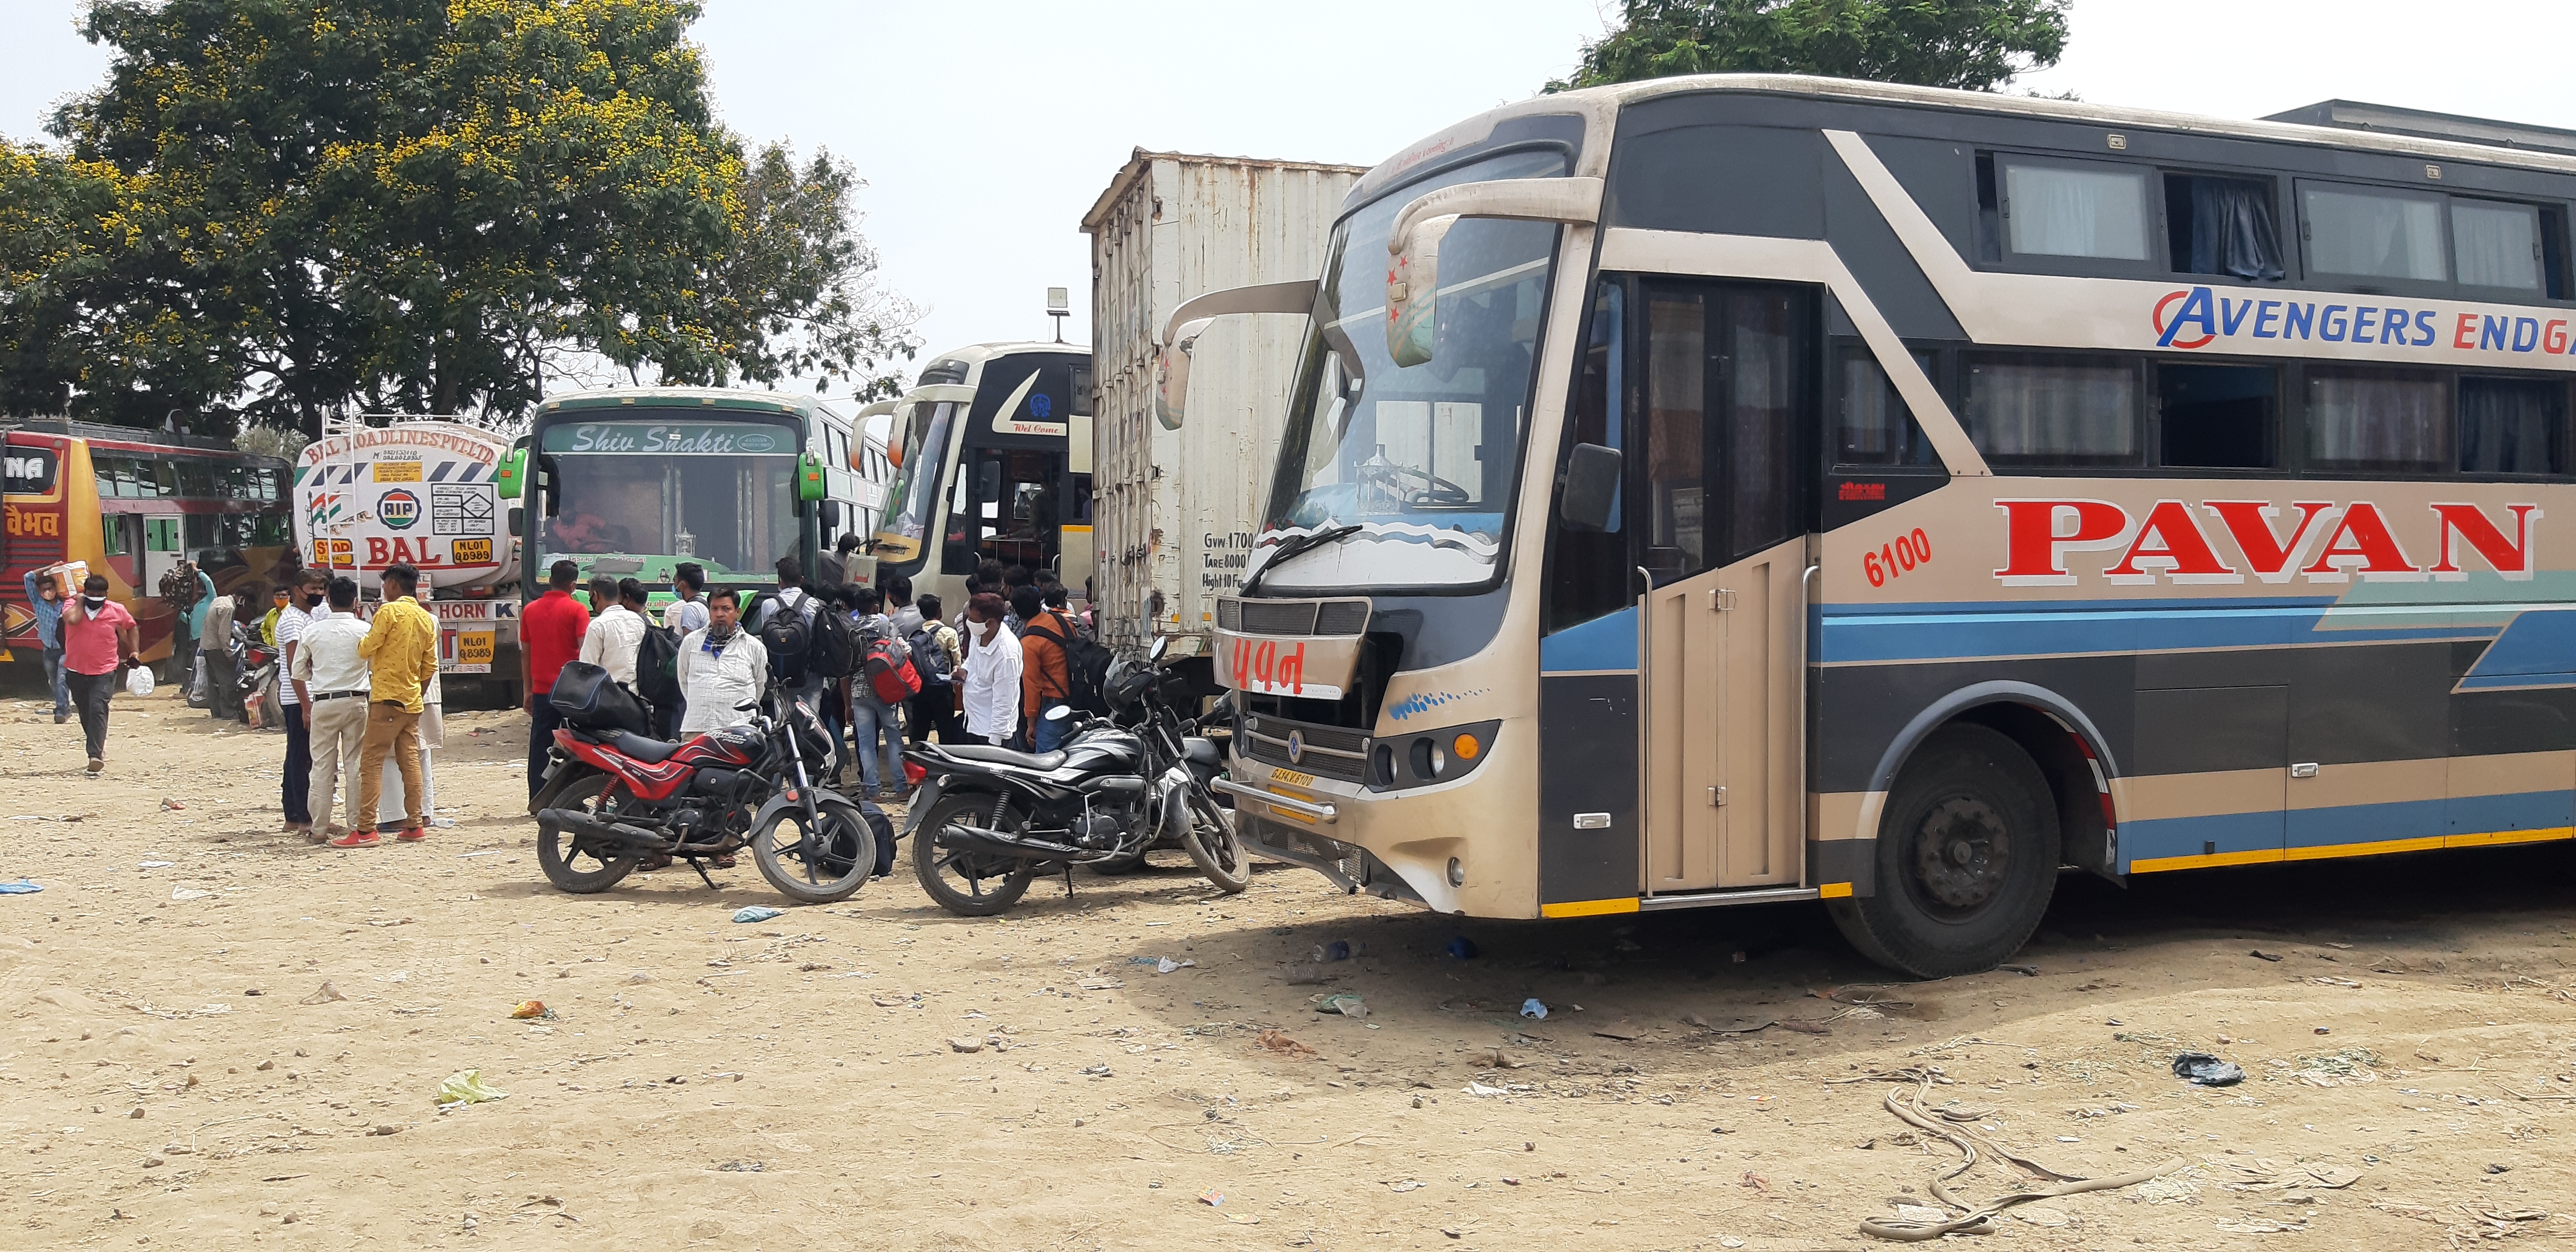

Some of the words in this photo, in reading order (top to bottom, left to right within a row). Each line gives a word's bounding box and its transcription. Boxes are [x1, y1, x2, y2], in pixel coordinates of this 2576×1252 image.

[2153, 288, 2435, 349] AVENGERS
[572, 425, 634, 452] Shiv
[642, 426, 735, 453] Shakti
[1013, 424, 1032, 432] Wel
[1034, 424, 1059, 434] Come
[305, 440, 340, 465] BAL
[4, 457, 44, 480] NA
[365, 536, 442, 565] BAL
[1993, 499, 2542, 584] PAVAN
[1863, 527, 1932, 588] 6100
[1202, 572, 1222, 591] Hight
[439, 603, 486, 619] HORN
[1232, 638, 1305, 695] પવન
